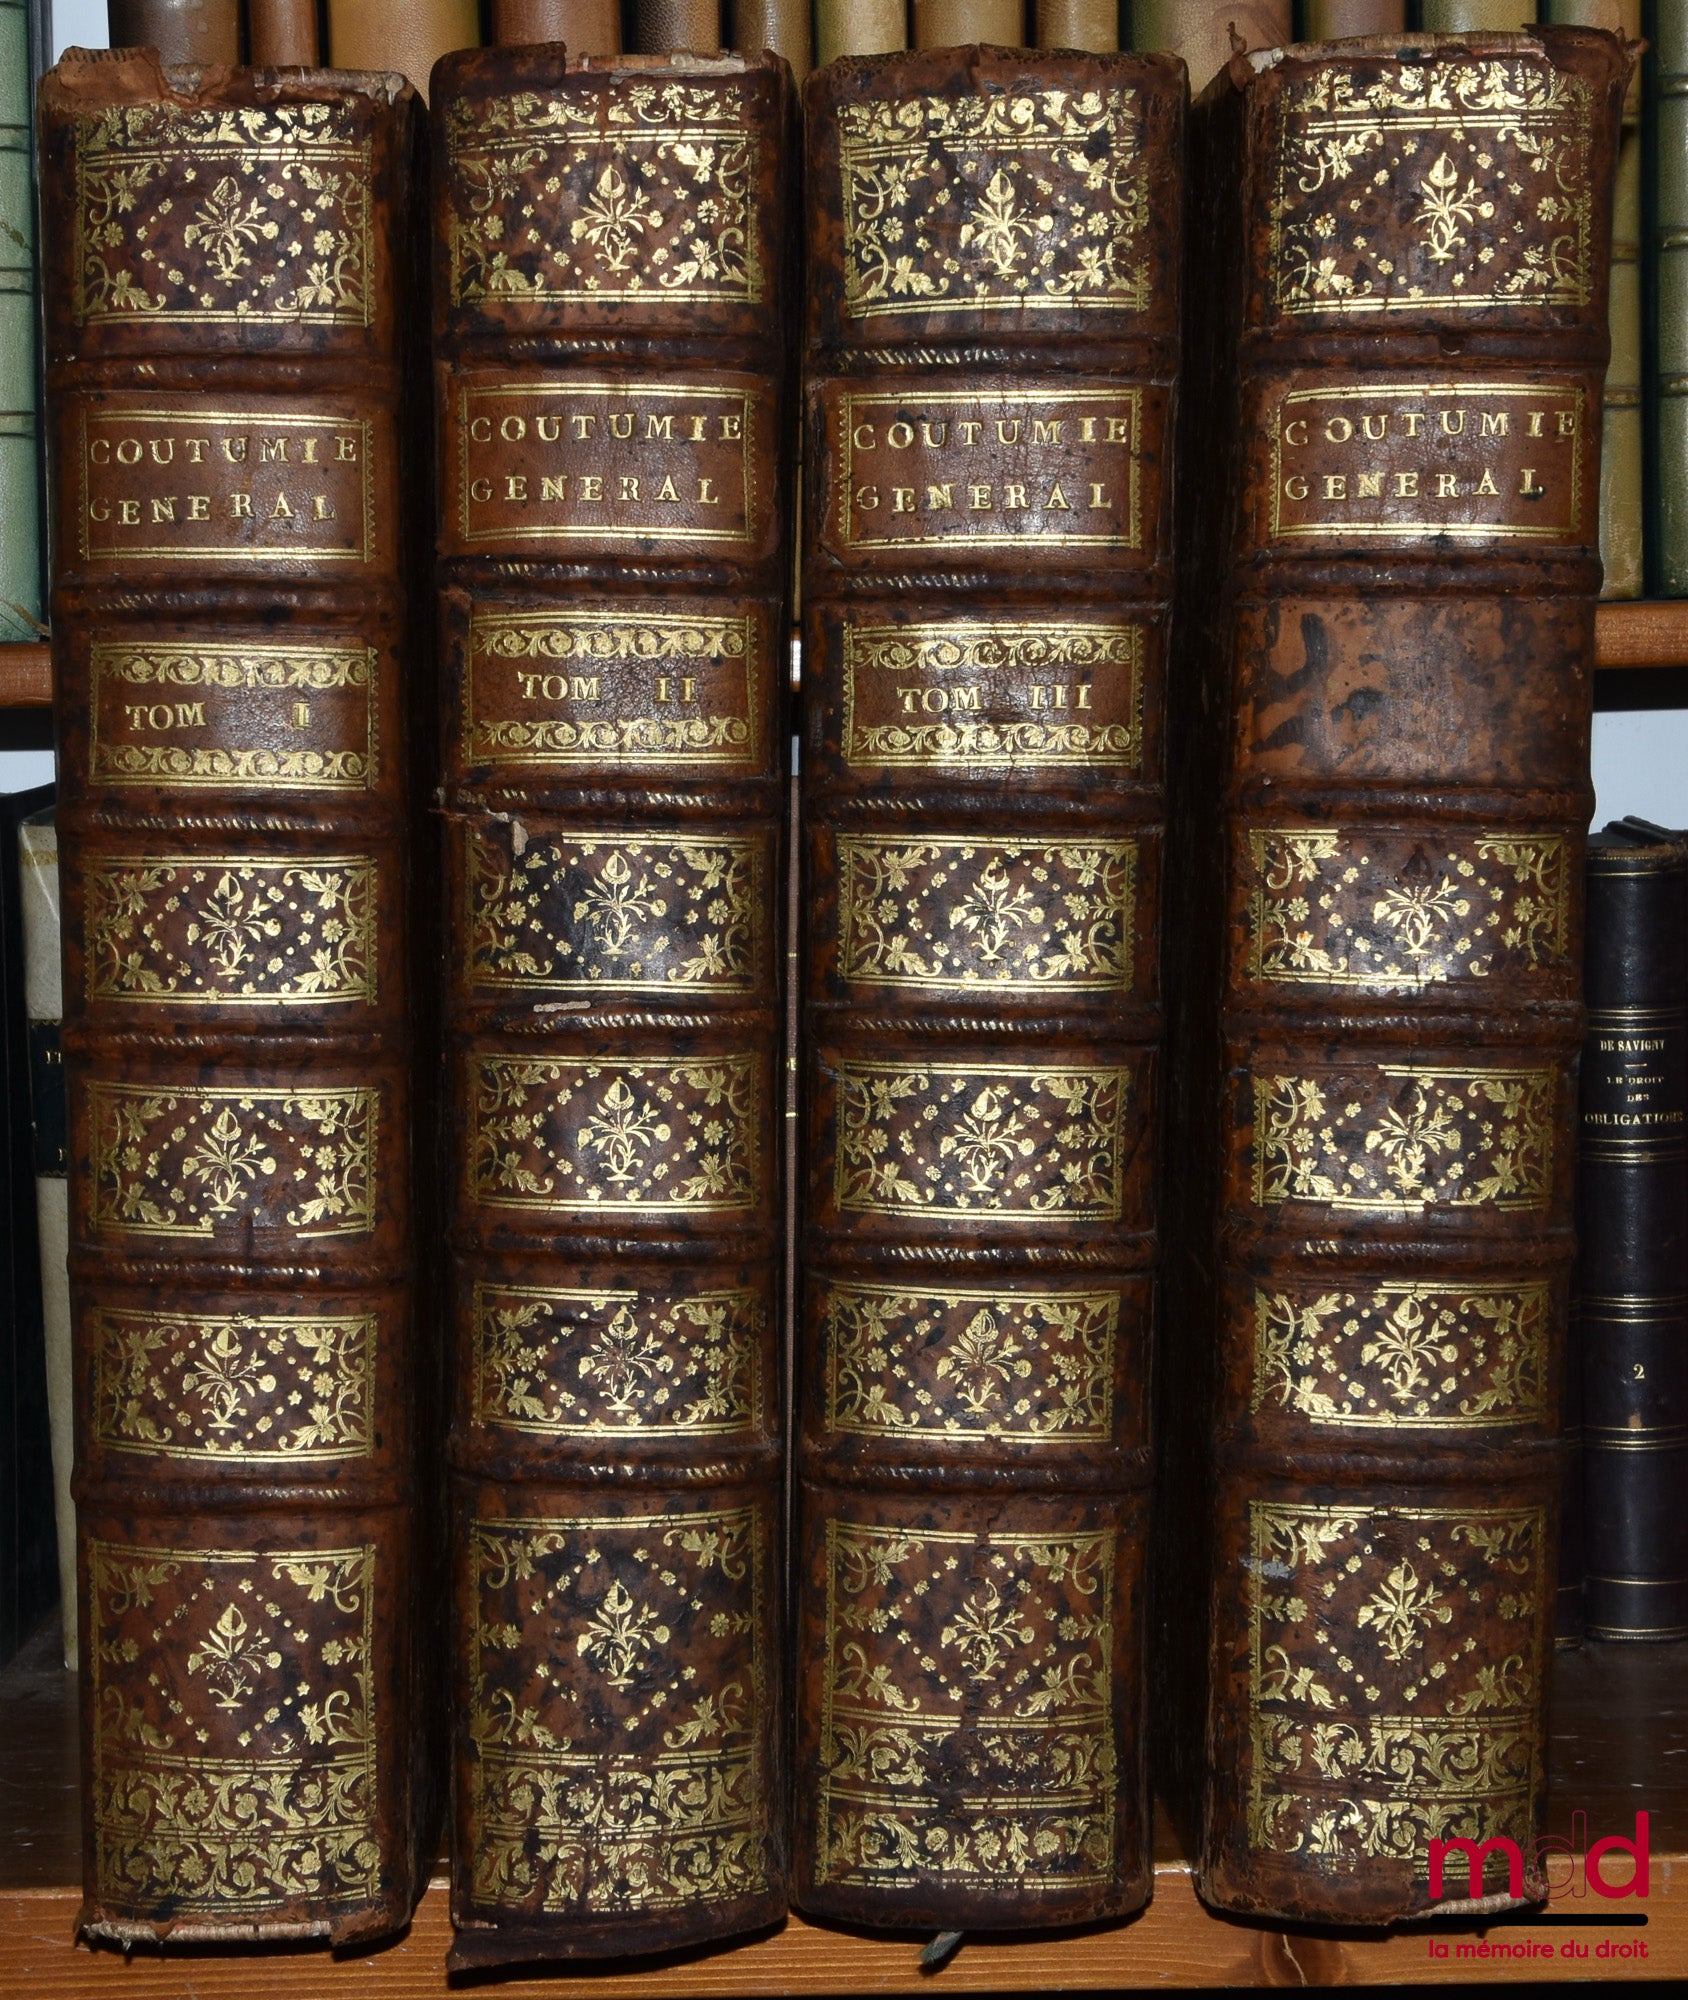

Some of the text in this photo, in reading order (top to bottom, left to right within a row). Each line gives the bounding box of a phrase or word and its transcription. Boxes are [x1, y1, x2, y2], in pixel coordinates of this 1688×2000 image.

[470, 413, 742, 442] COUTUMIE
[853, 417, 1128, 450] COUTUMIE
[1285, 410, 1575, 446] COUTUMIE
[91, 436, 357, 465] COUTUMIE
[470, 475, 719, 504] GENERAL
[856, 482, 1112, 513] GENERAL
[1284, 468, 1544, 501] GENERAL
[90, 492, 337, 525] GENERAL
[518, 671, 697, 702] TOM II
[896, 684, 1092, 714] TOM III
[125, 701, 312, 732] TOM I
[1600, 1039, 1664, 1052] DE SAVIGNY
[1585, 1111, 1683, 1126] OBLIGATIONS
[1633, 1363, 1645, 1380] 2
